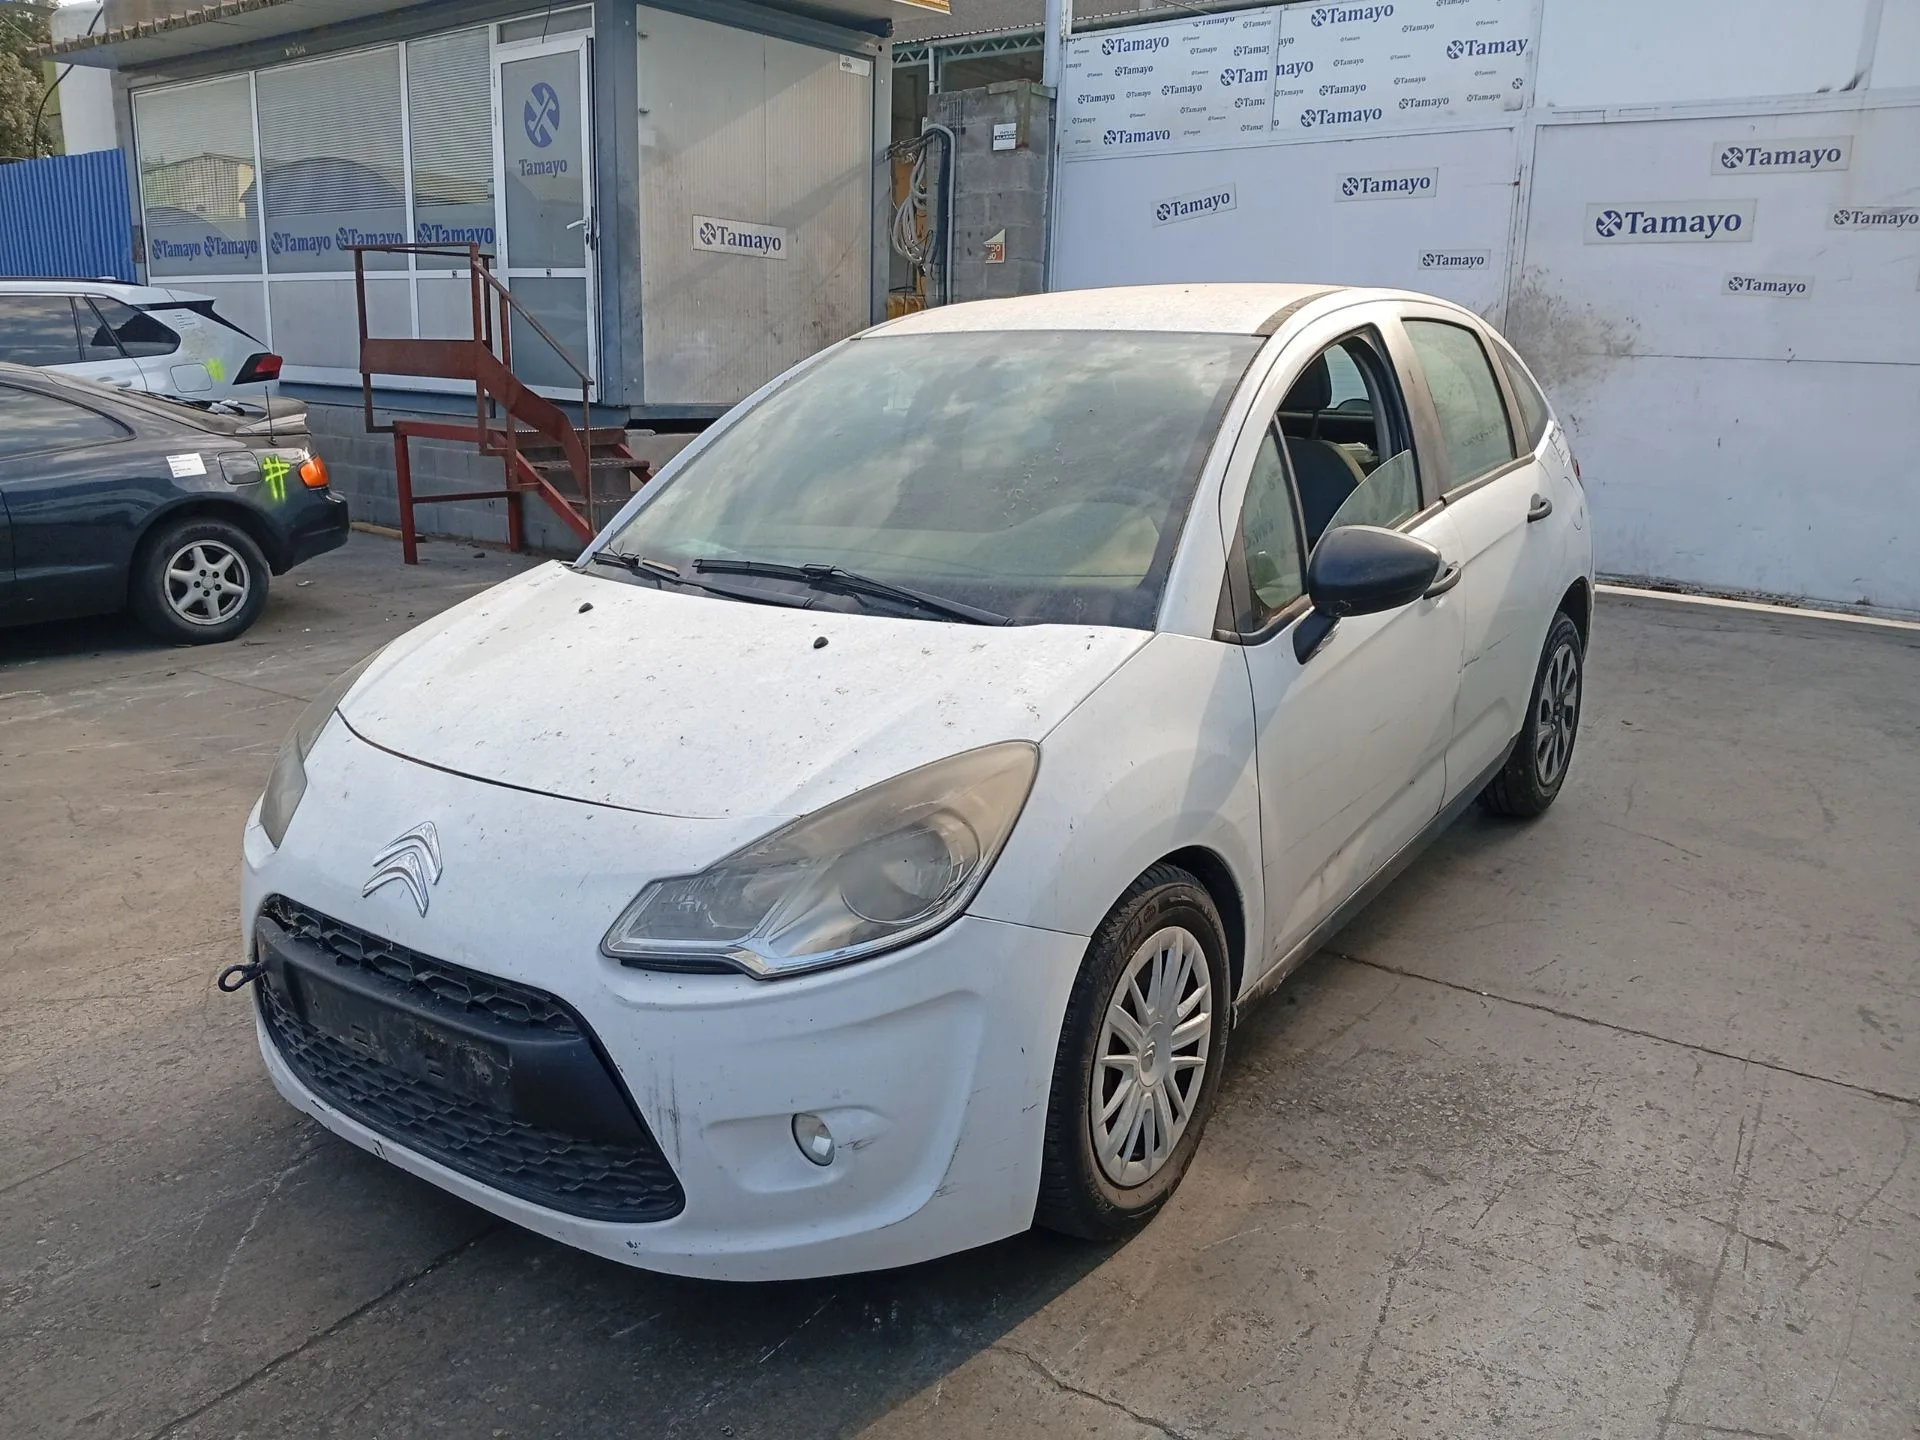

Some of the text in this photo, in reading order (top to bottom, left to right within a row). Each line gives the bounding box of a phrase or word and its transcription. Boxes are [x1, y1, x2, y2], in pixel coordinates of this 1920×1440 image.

[1328, 4, 1394, 23] Tamayo
[1409, 23, 1434, 32] Tamayo
[1115, 36, 1169, 53] Tamayo
[1465, 38, 1529, 56] Tamay
[1122, 65, 1154, 75] Tamayo
[1340, 58, 1364, 66] Tamayo
[1236, 68, 1268, 84] Tam
[1400, 76, 1426, 85] Tamayo
[1170, 84, 1202, 94] Tamayo
[1329, 84, 1367, 95] Tamayo
[1473, 93, 1501, 101] Tamayo
[1085, 94, 1115, 103] Tamayo
[1409, 97, 1450, 108] Tamayo
[1185, 106, 1207, 114] Tamayo
[1316, 107, 1382, 125] Tamayo
[1745, 147, 1841, 168] Tamayo
[518, 158, 568, 179] Tamayo
[1359, 175, 1431, 194] Tamayo
[1170, 191, 1230, 217] Tamayo
[1625, 211, 1742, 239] Tamayo
[1852, 210, 1920, 228] Tamayo
[431, 224, 494, 246] Tamayo
[717, 225, 782, 255] Tamayo
[160, 240, 201, 261] Tamayo
[213, 237, 258, 260] Tamayo
[281, 233, 331, 256] Tamayo
[1435, 253, 1485, 268] Tamayo
[1744, 277, 1807, 294] Tamayo
